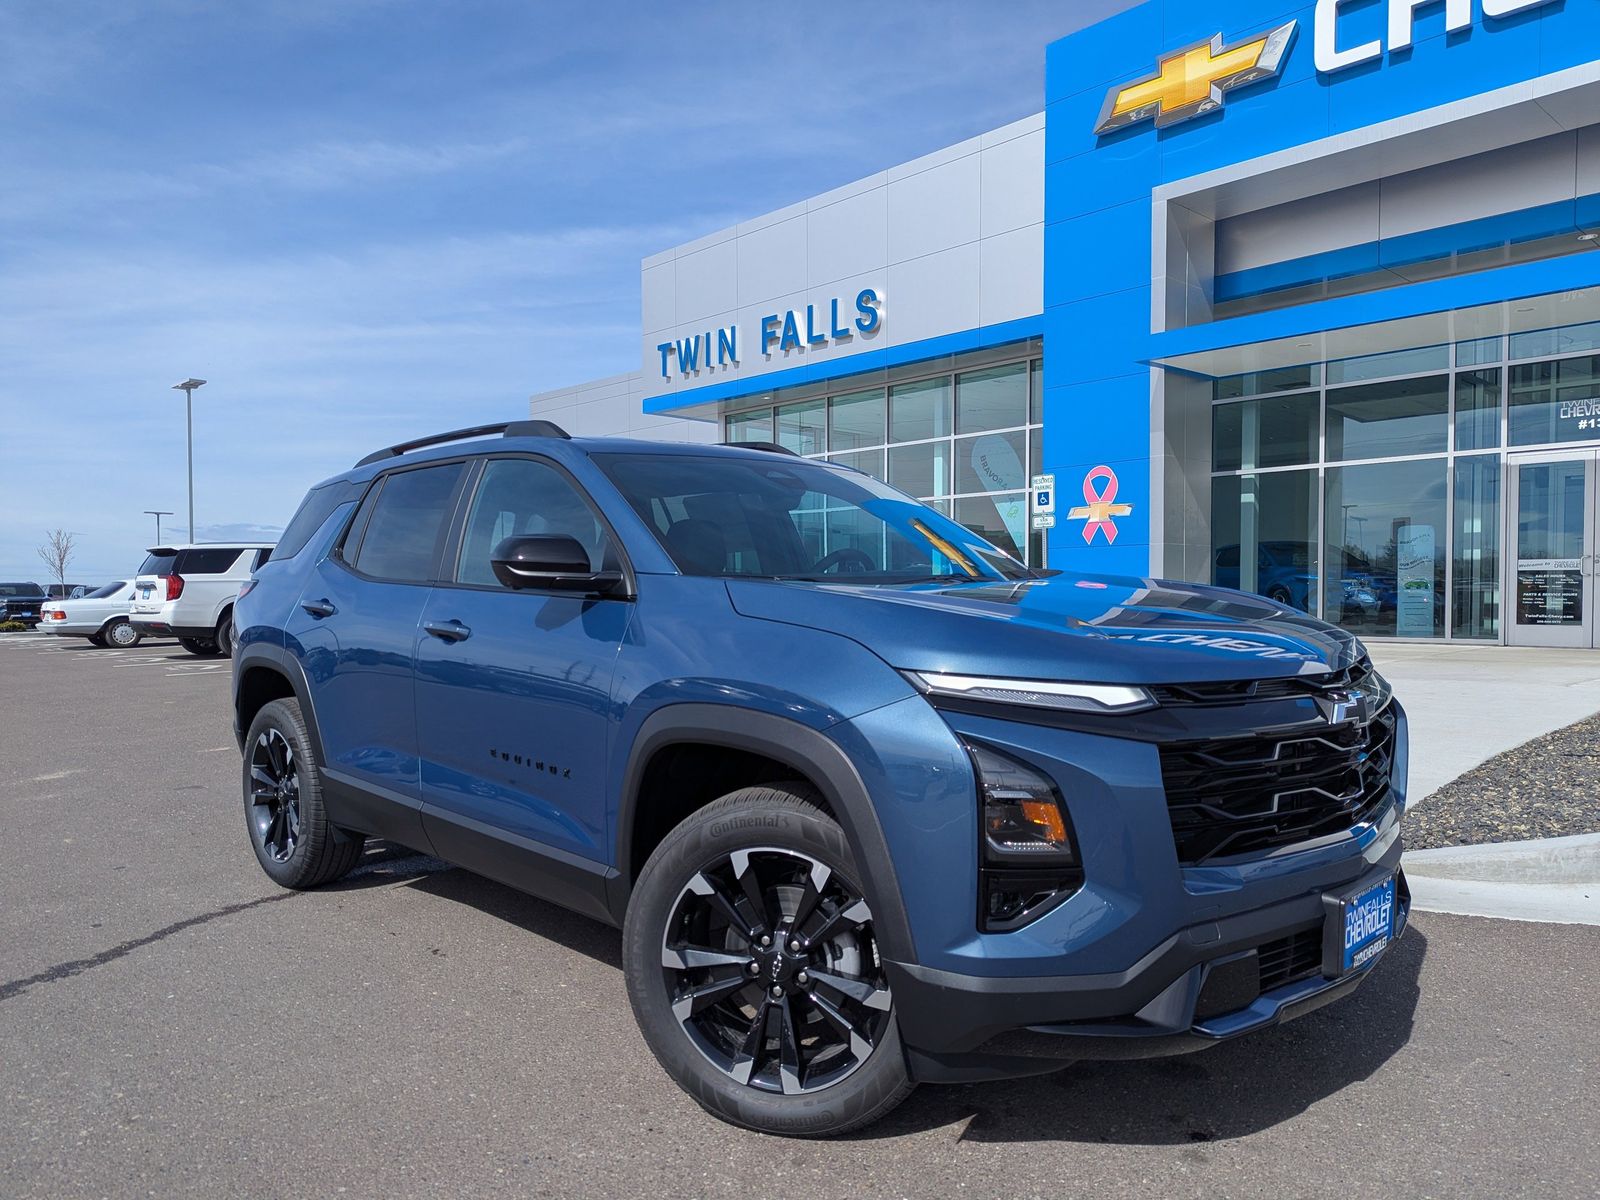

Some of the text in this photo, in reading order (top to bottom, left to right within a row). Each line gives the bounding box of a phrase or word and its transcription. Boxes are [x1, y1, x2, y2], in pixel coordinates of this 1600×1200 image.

[1314, 0, 1552, 72] CH
[657, 288, 879, 377] TWIN FALLS
[709, 814, 779, 838] Continental
[1344, 903, 1392, 949] CHEVROLET
